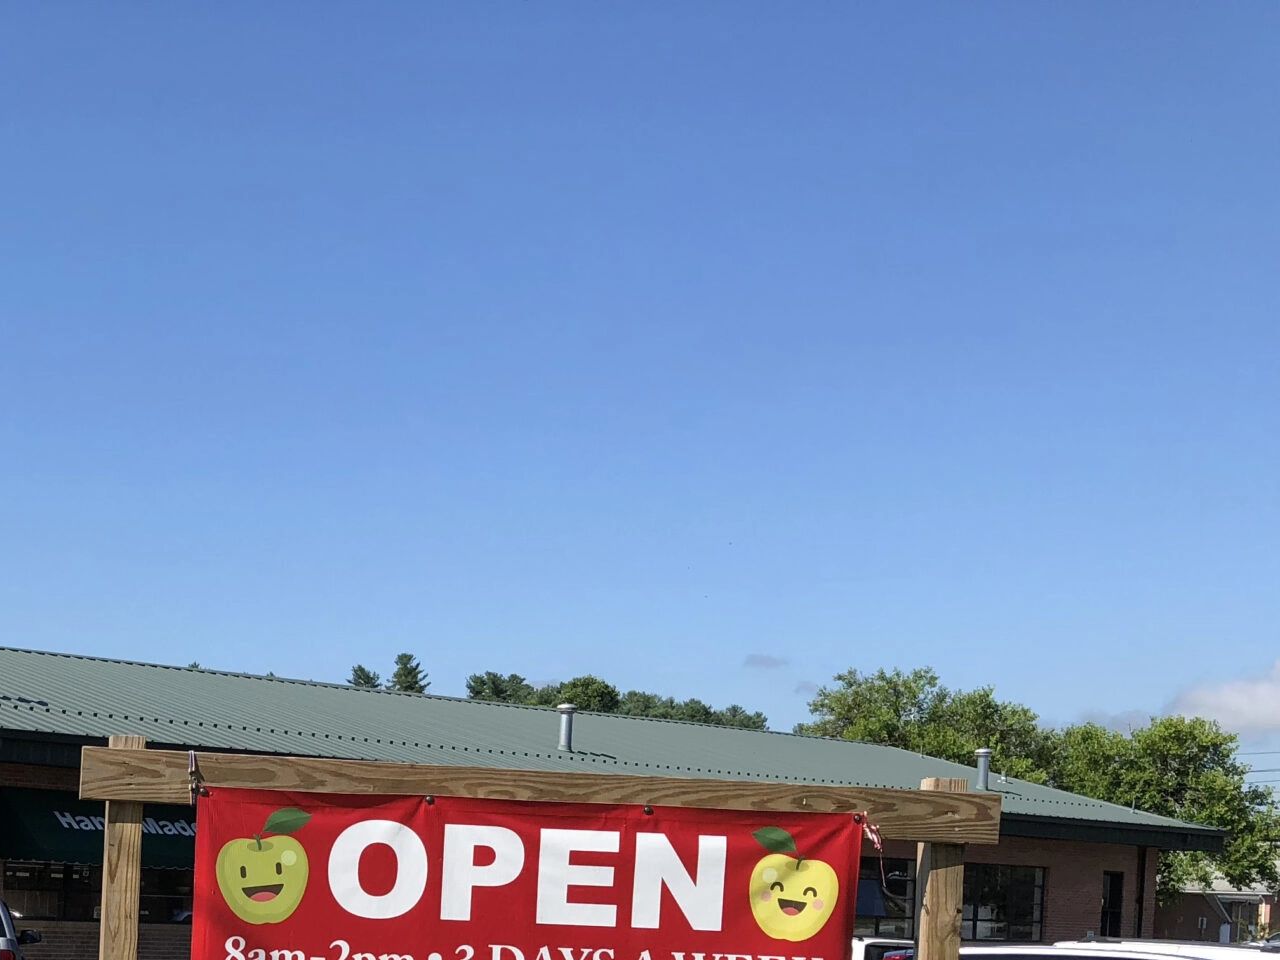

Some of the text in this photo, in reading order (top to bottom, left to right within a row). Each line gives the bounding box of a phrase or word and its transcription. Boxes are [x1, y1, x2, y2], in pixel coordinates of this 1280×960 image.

[53, 810, 196, 836] Han Mad
[327, 819, 727, 932] OPEN
